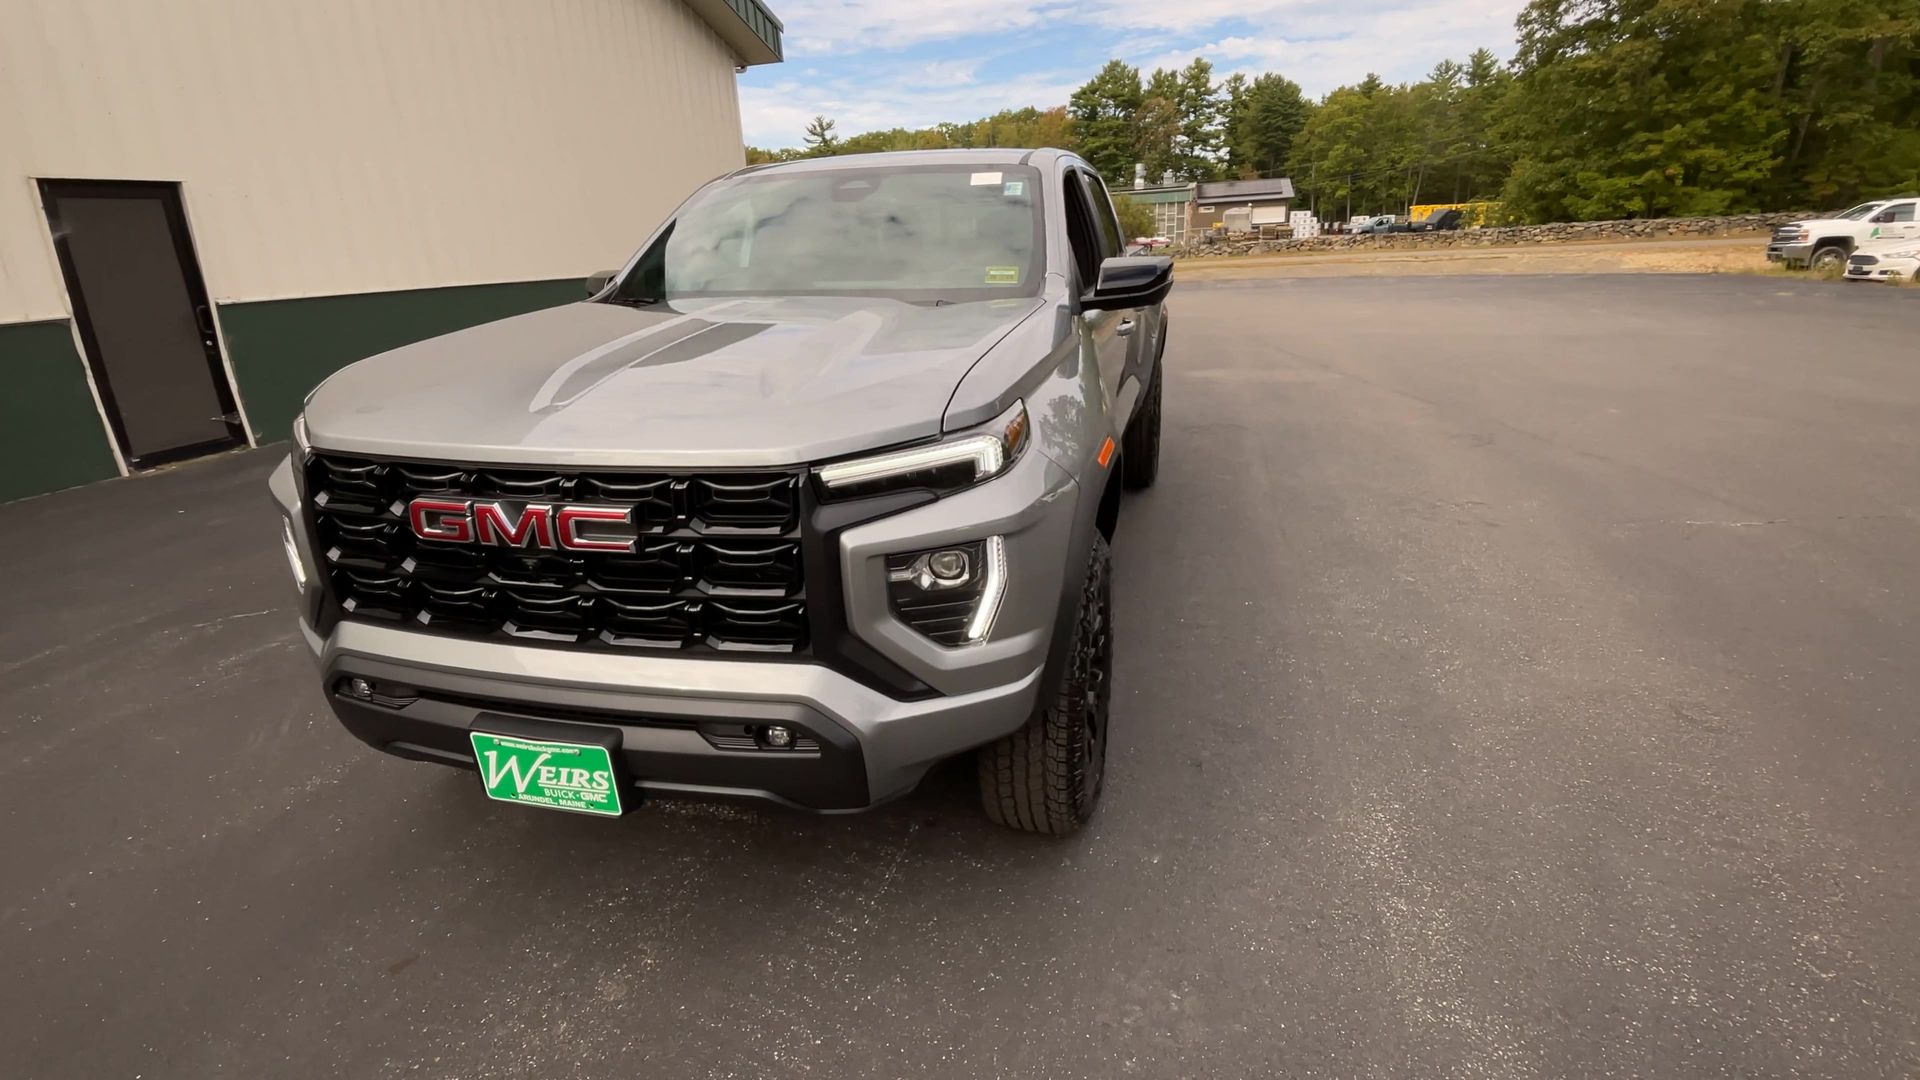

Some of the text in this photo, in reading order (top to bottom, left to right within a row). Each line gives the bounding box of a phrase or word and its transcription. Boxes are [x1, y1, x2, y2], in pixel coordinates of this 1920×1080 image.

[409, 498, 635, 553] GMC
[518, 793, 587, 809] ARUNDEL, MAINE
